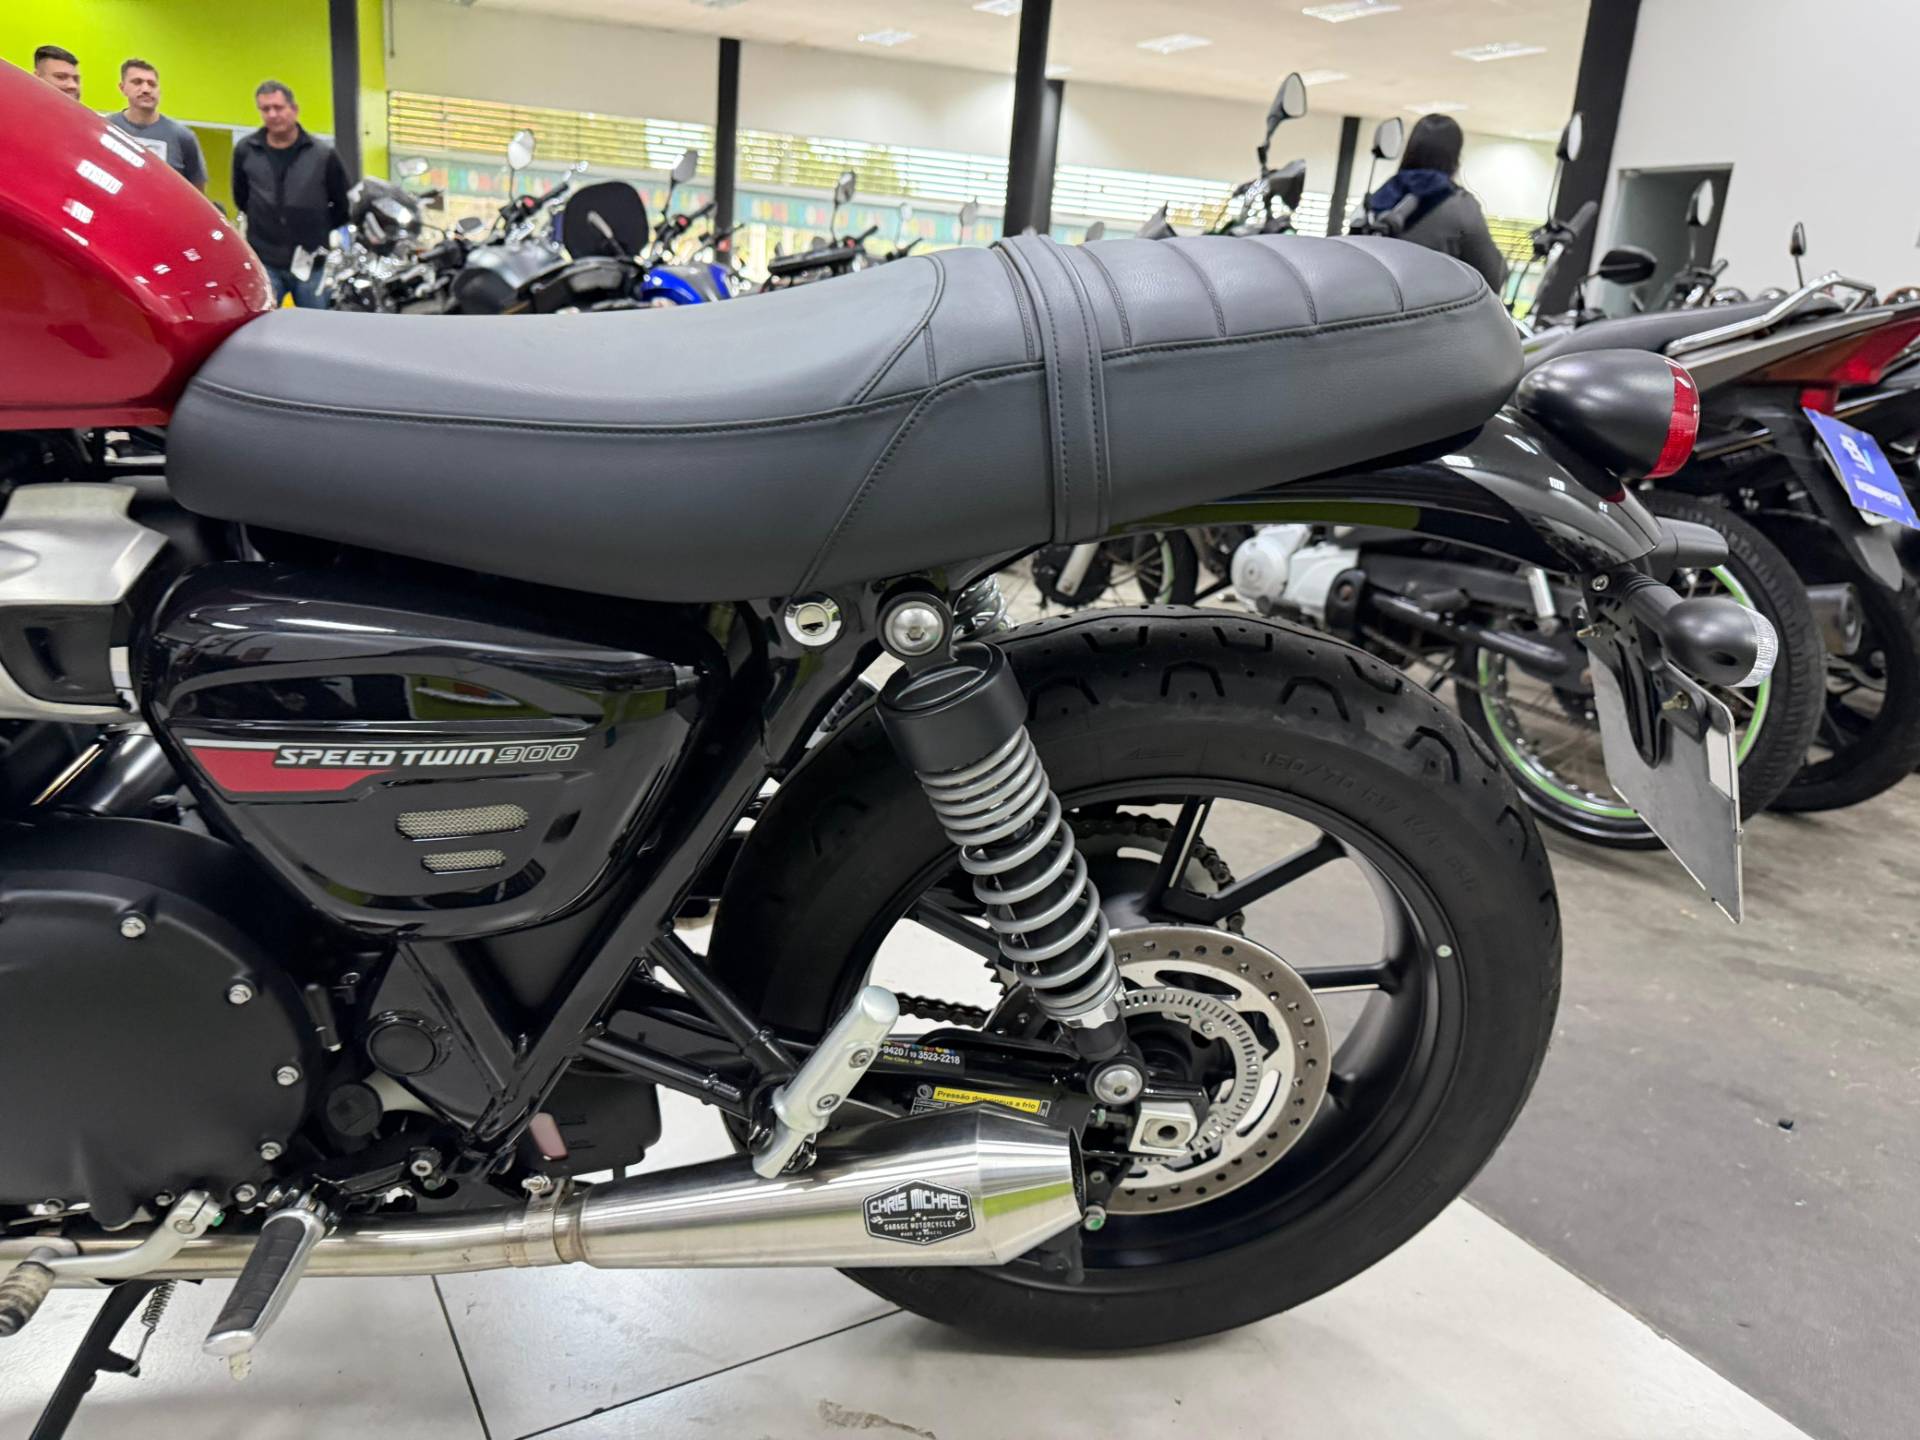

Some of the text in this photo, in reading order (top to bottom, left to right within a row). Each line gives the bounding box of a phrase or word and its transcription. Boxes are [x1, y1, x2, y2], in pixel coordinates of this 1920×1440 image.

[275, 744, 580, 766] SPEED TWIN 900
[918, 1050, 960, 1064] 3523-2218
[937, 1090, 969, 1101] Pressão
[1022, 1099, 1036, 1109] frio
[869, 1188, 968, 1214] CHRIS MICHAEL
[910, 1220, 956, 1230] MOTORCYCLES
